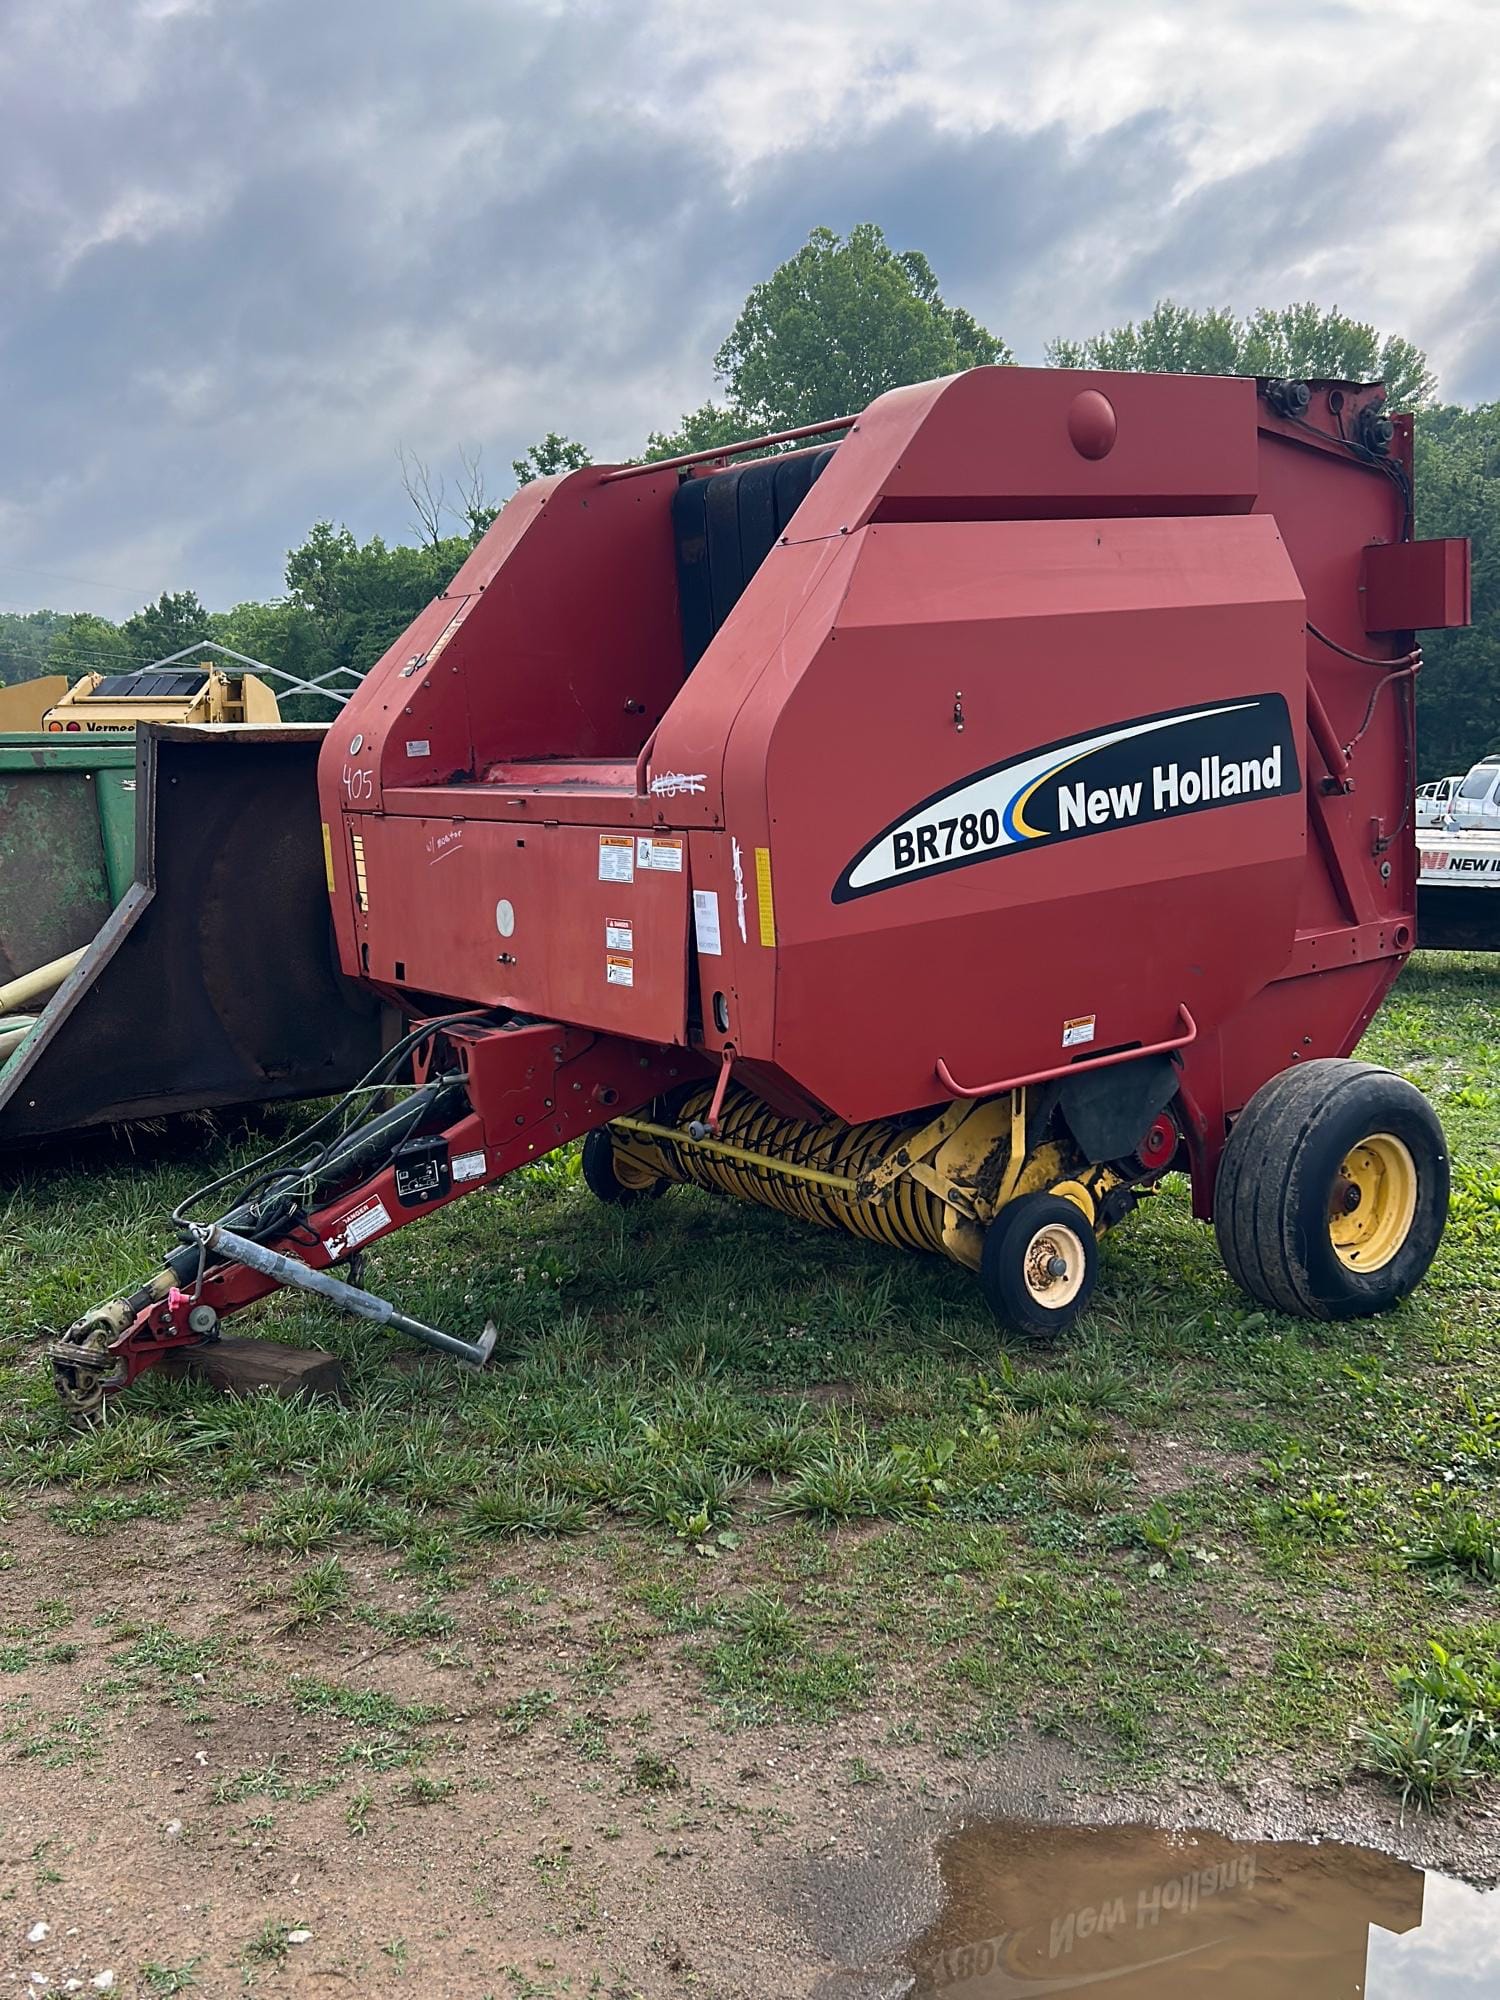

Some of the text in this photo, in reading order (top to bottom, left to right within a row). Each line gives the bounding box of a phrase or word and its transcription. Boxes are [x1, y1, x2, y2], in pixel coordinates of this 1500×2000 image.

[86, 722, 136, 731] Vermee
[341, 763, 374, 801] 405
[1057, 745, 1282, 832] New Holland
[892, 808, 1000, 871] BR780
[1449, 858, 1490, 872] NEW
